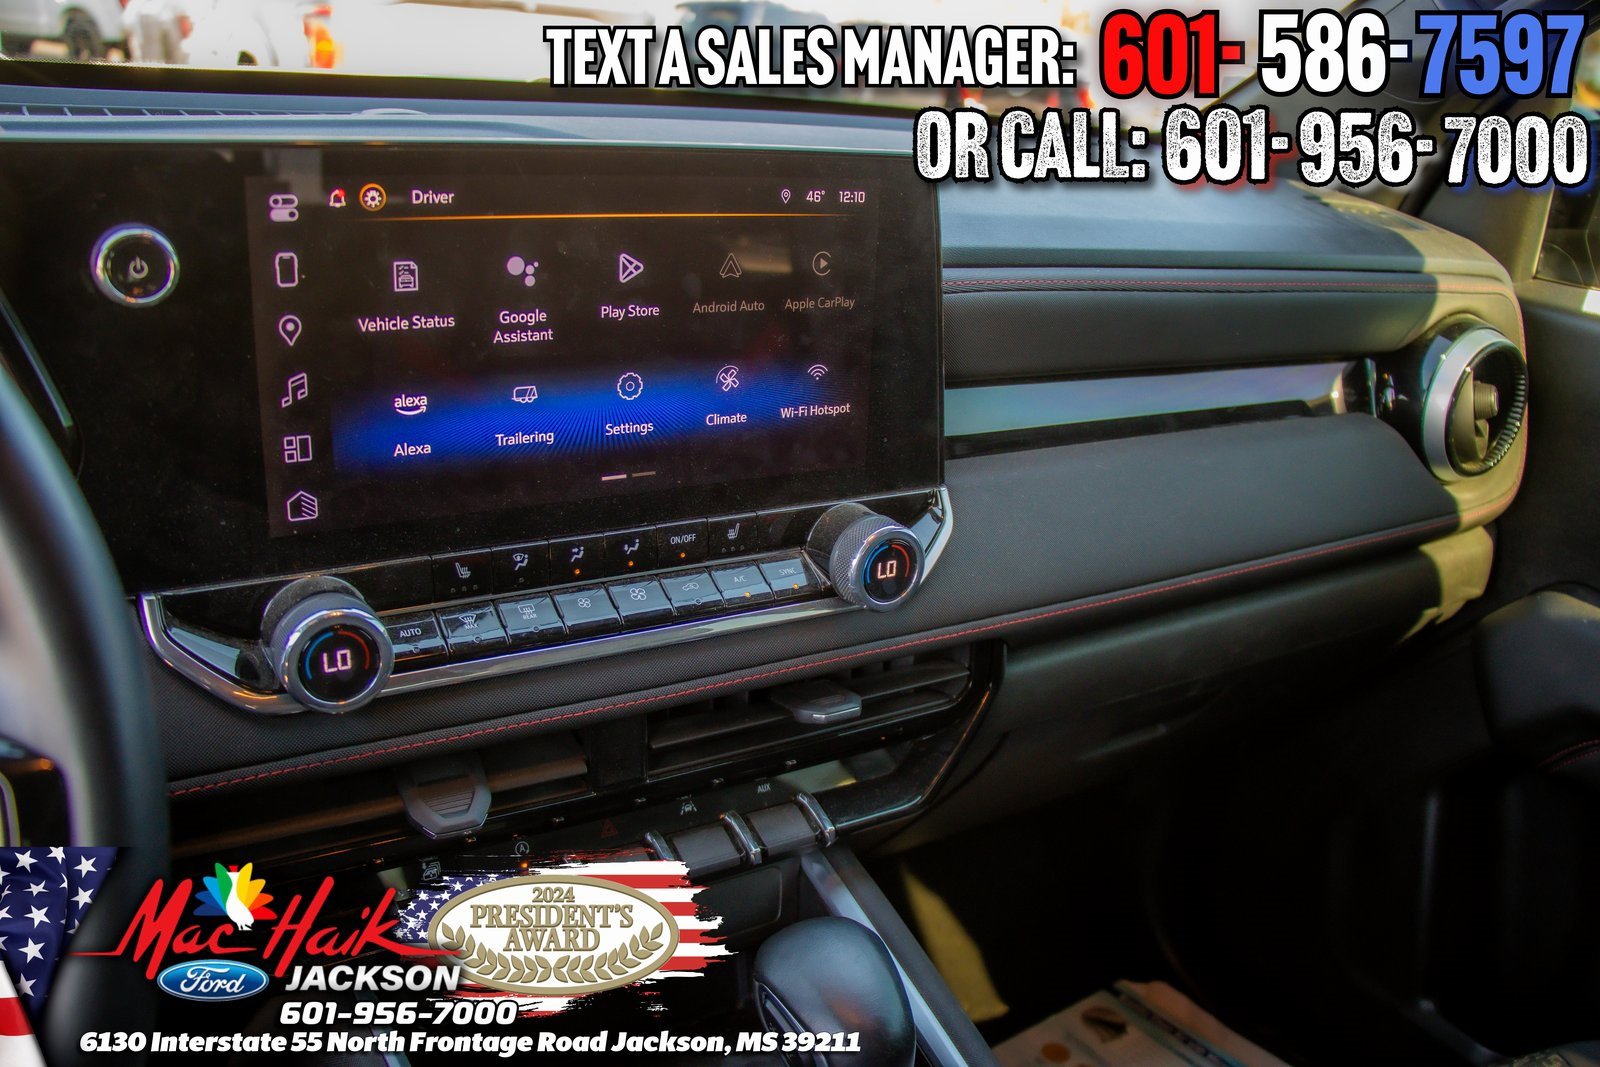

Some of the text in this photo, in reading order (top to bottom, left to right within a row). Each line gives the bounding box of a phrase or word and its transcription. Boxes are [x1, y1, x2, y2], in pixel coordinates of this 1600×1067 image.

[411, 190, 455, 205] Driver
[806, 190, 826, 203] 46°
[839, 191, 865, 203] 12:10
[693, 301, 765, 314] Android Auto
[785, 297, 855, 311] Apple CarPlay
[499, 309, 547, 326] Google
[601, 305, 660, 321] Play Store
[358, 316, 456, 332] Vehicle Status
[493, 329, 554, 344] Assistant
[394, 394, 428, 408] alexa
[780, 402, 851, 419] Wi-Fi Hotspot
[706, 412, 748, 427] Climate
[605, 421, 654, 437] Settings
[495, 431, 555, 447] Trailering
[394, 443, 431, 458] Alexa
[670, 533, 696, 545] ON/OFF
[778, 567, 797, 577] SYNC
[876, 560, 897, 580] LO
[522, 612, 538, 620] REAR
[399, 627, 422, 639] AUTO
[322, 649, 353, 674] LO
[757, 783, 771, 794] AUX
